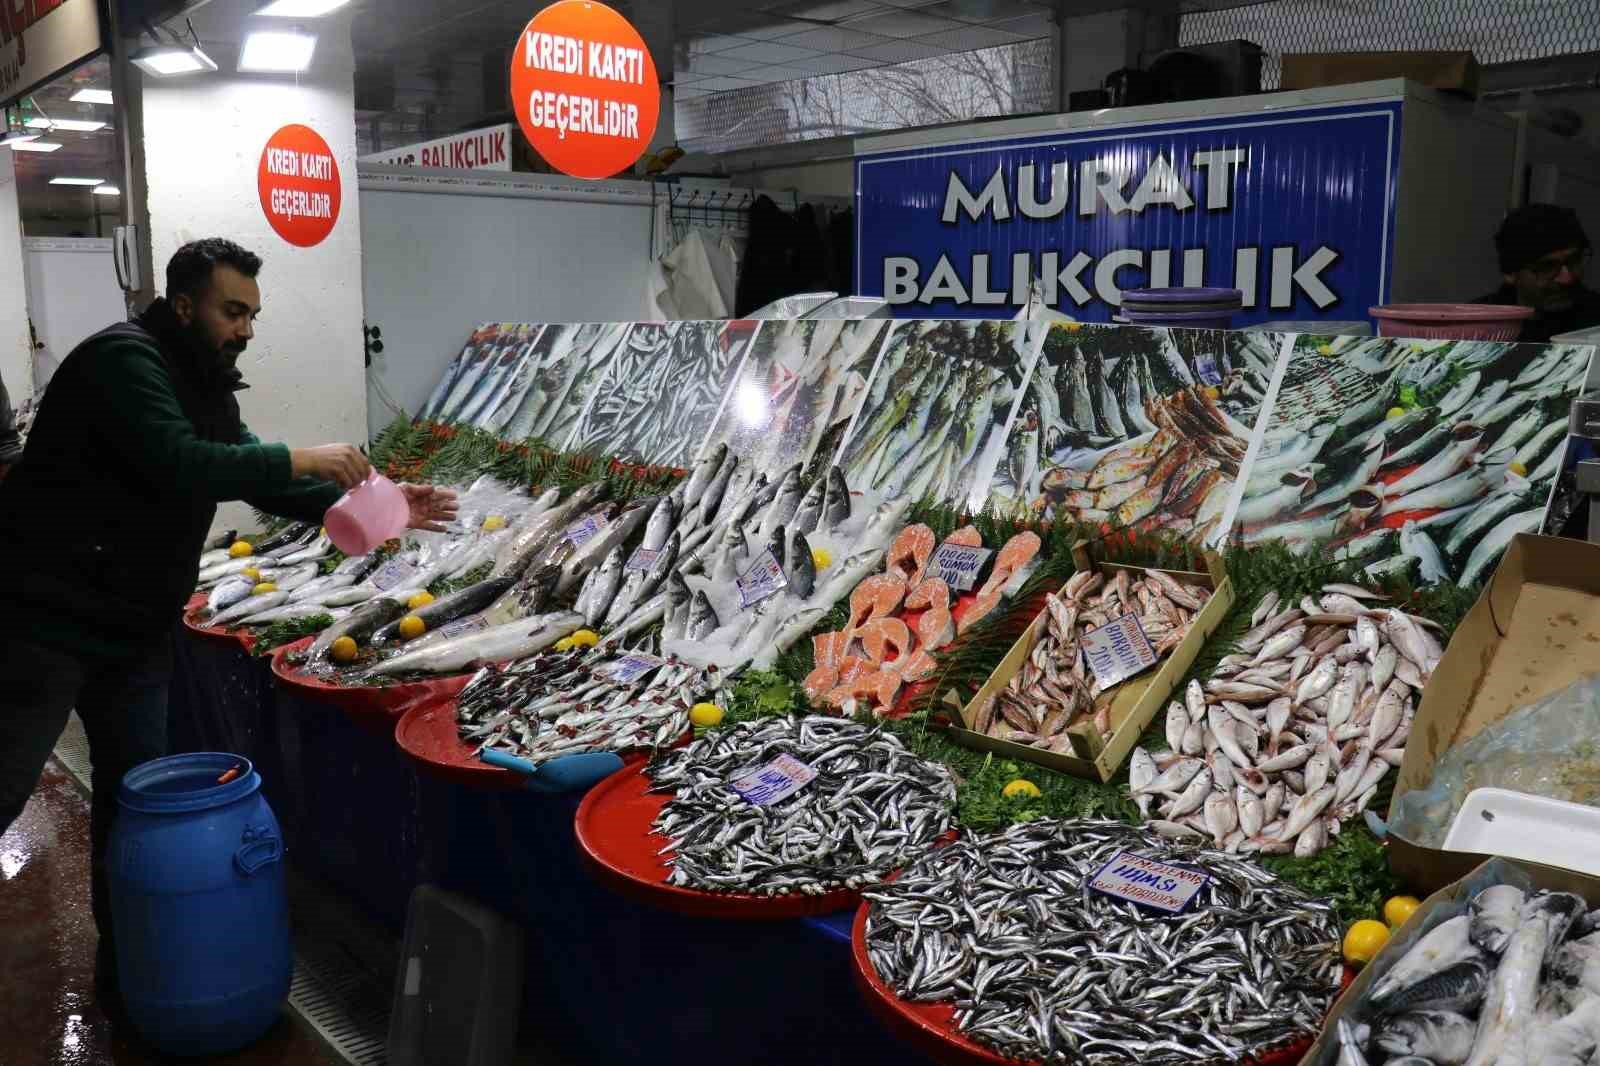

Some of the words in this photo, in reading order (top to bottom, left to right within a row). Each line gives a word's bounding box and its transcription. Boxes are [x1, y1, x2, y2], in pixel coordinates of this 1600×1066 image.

[588, 41, 644, 85] KARTI
[302, 152, 332, 181] KARTI
[940, 147, 1246, 224] MURAT
